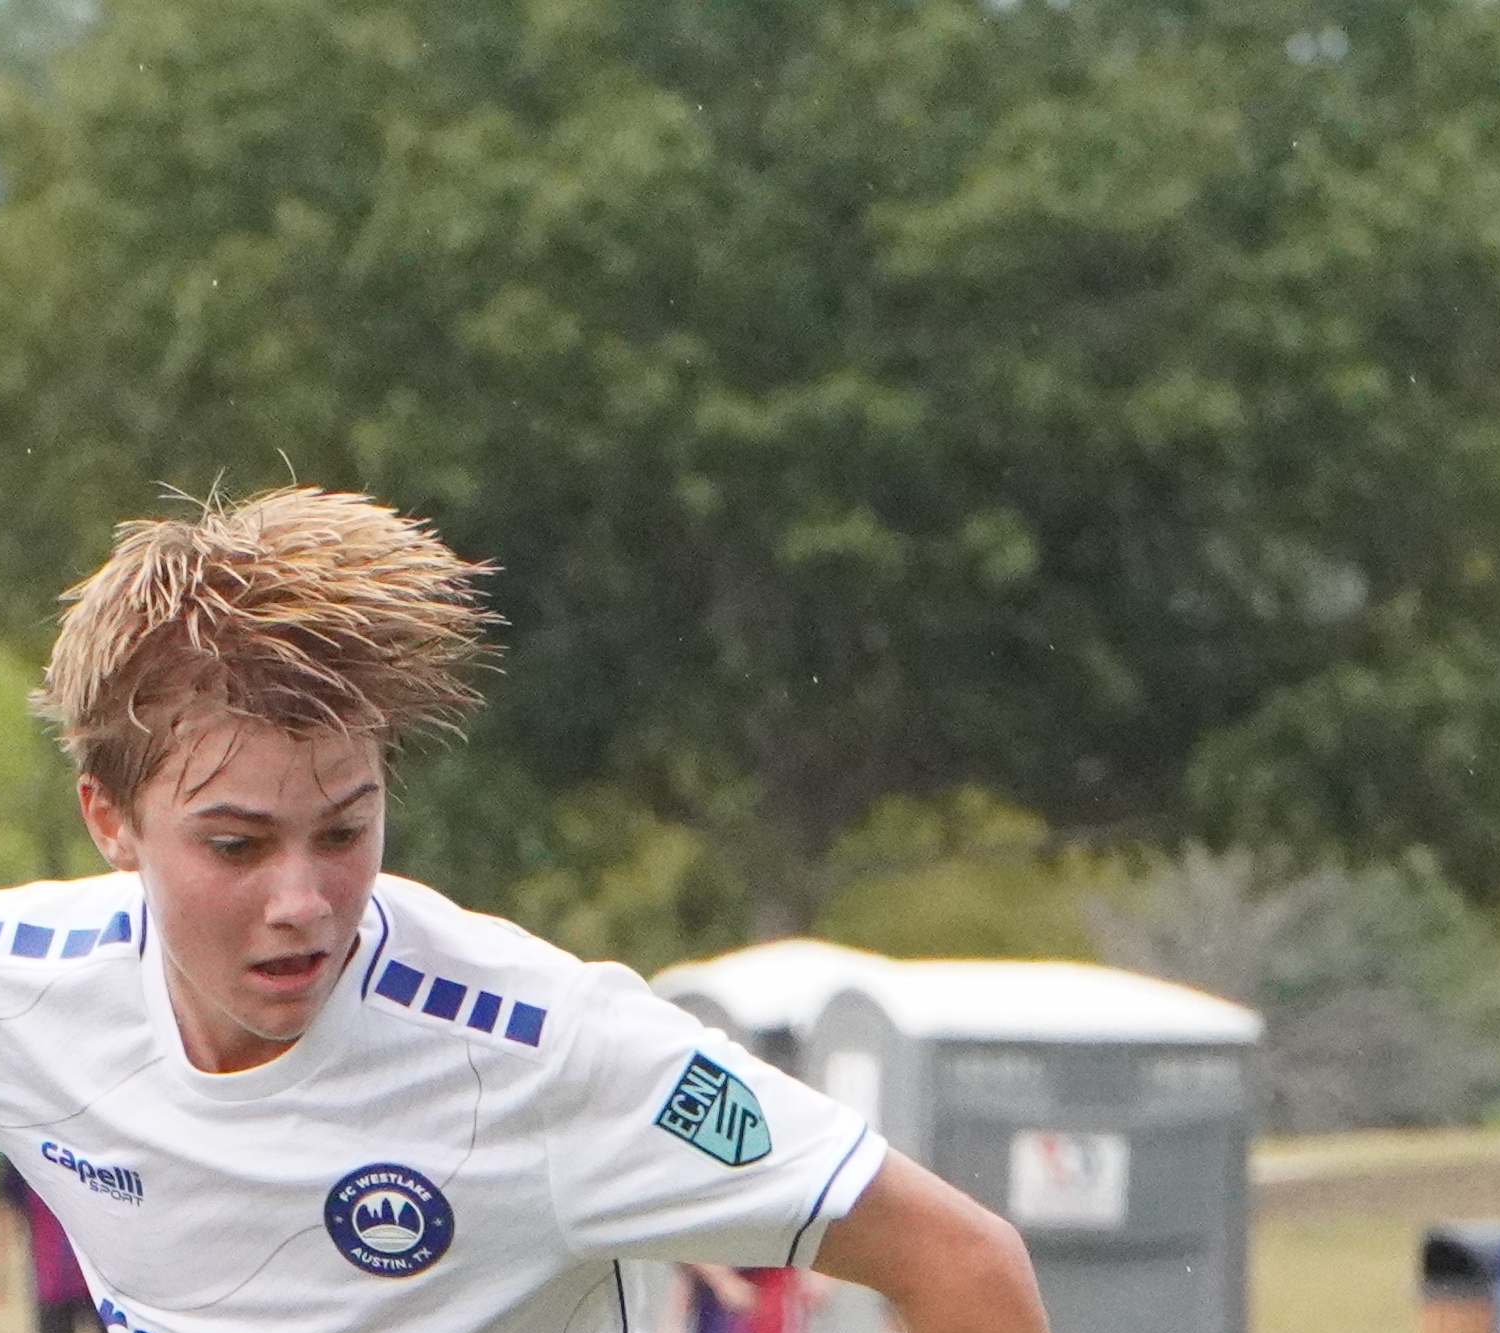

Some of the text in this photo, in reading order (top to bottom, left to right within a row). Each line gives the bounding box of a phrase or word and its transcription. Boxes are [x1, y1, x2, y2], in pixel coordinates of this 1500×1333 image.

[660, 1064, 727, 1138] ECNL
[41, 1141, 144, 1197] capelli
[89, 1180, 145, 1208] SPORT
[338, 1173, 433, 1203] FC WESTLAKE
[411, 1246, 433, 1263] TX
